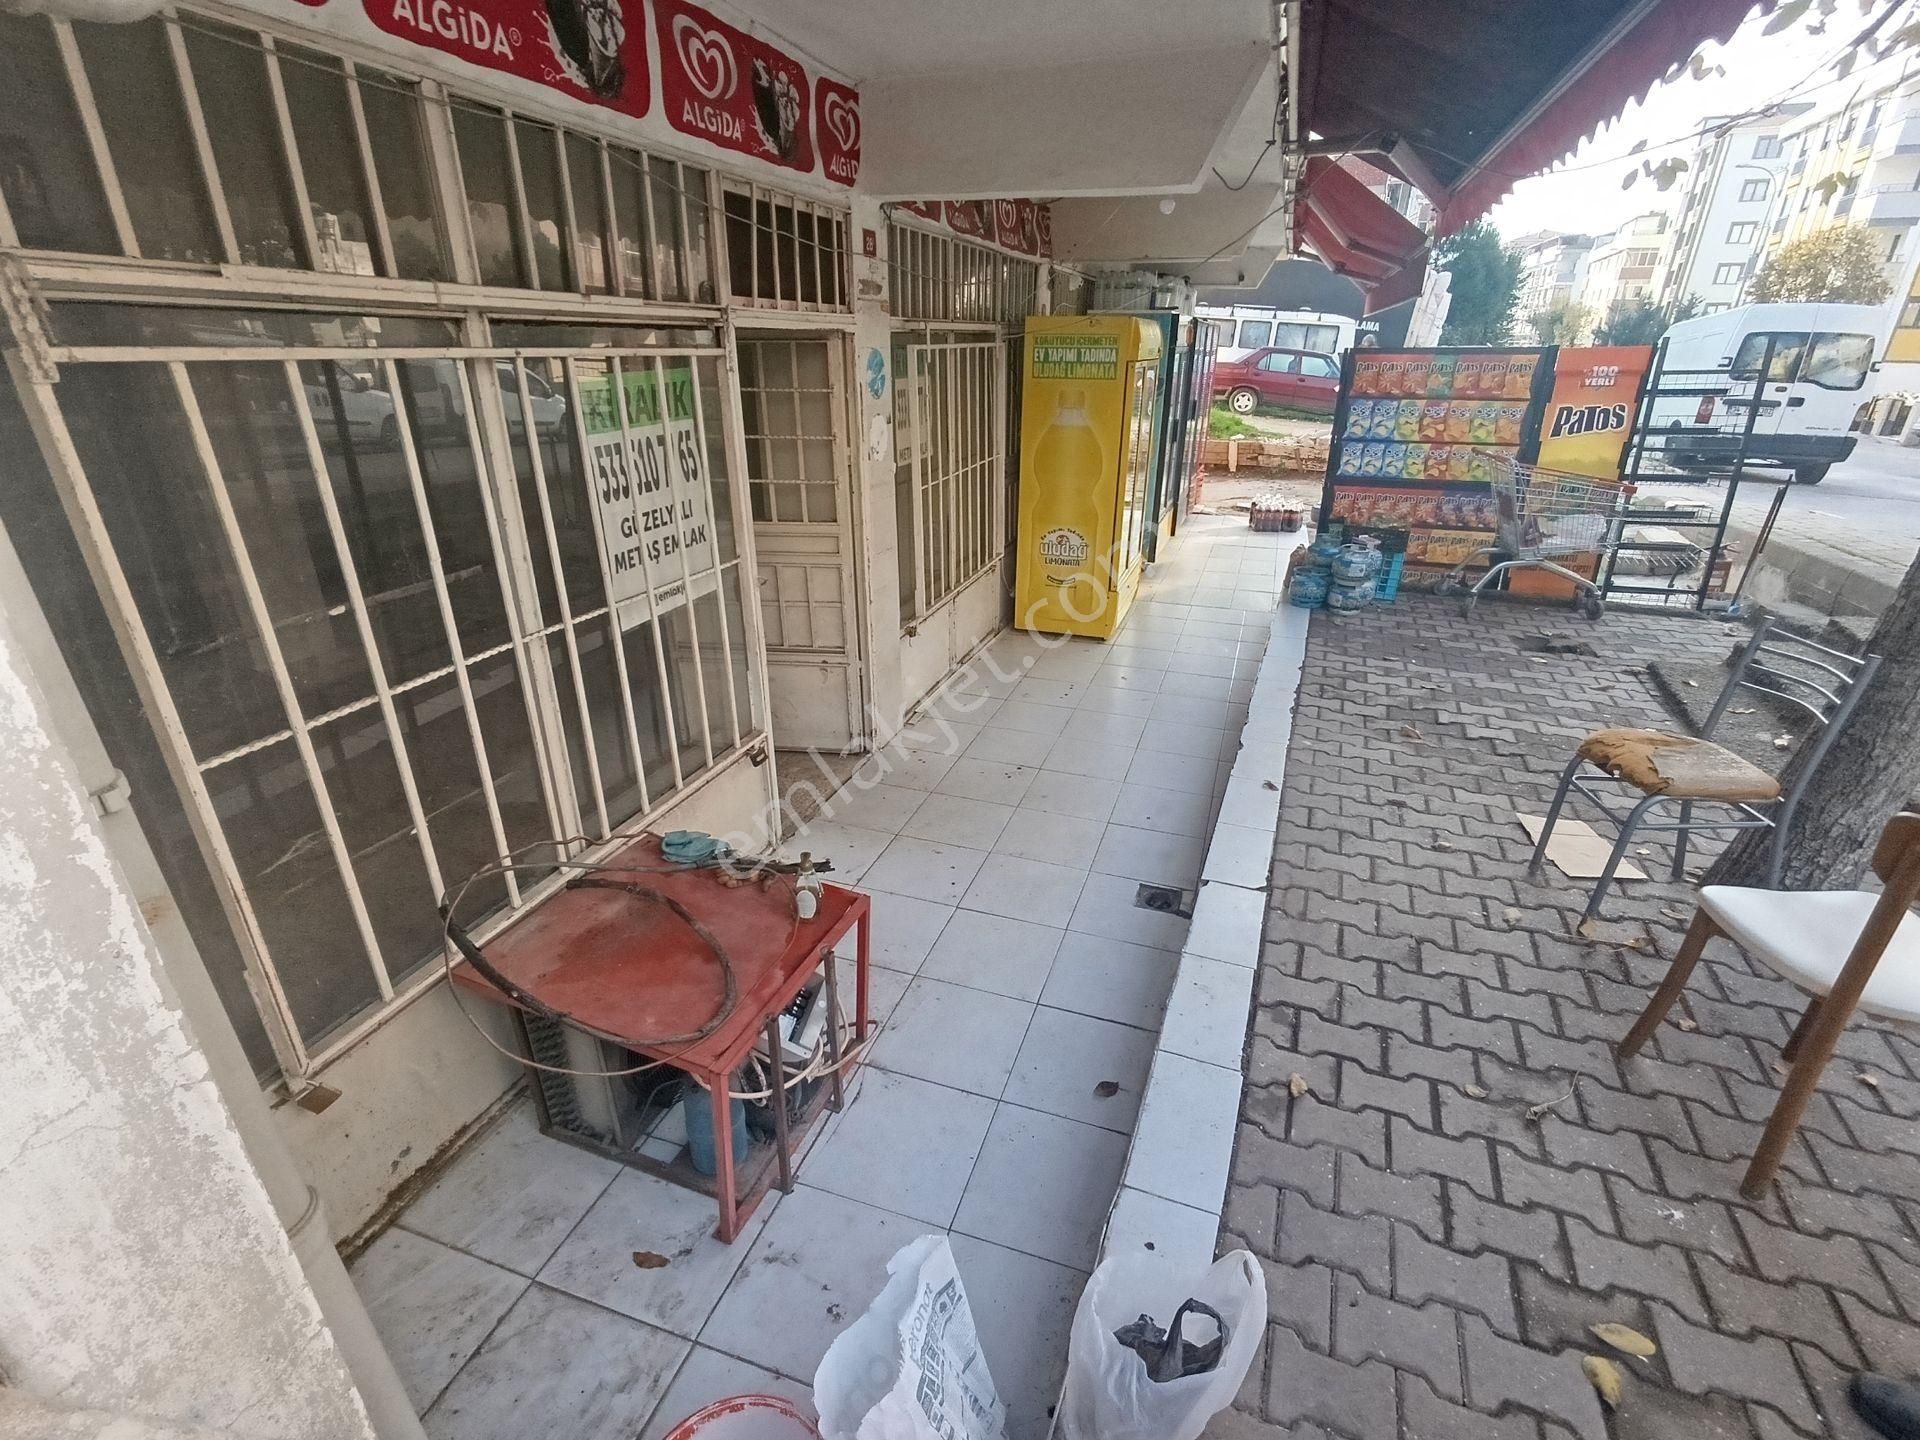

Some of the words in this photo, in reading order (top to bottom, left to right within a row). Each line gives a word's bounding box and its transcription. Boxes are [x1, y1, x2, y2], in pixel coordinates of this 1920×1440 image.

[829, 153, 858, 178] ALGiD
[1355, 320, 1380, 332] LAMA
[1034, 348, 1045, 362] EV
[1048, 348, 1078, 362] YAPIMI
[1081, 348, 1117, 362] TADINDA
[594, 442, 630, 505] 533
[678, 430, 698, 483] 65
[621, 499, 693, 539] GÜZELYLI
[663, 524, 707, 556] EMLAK
[658, 582, 686, 602] emlakj
